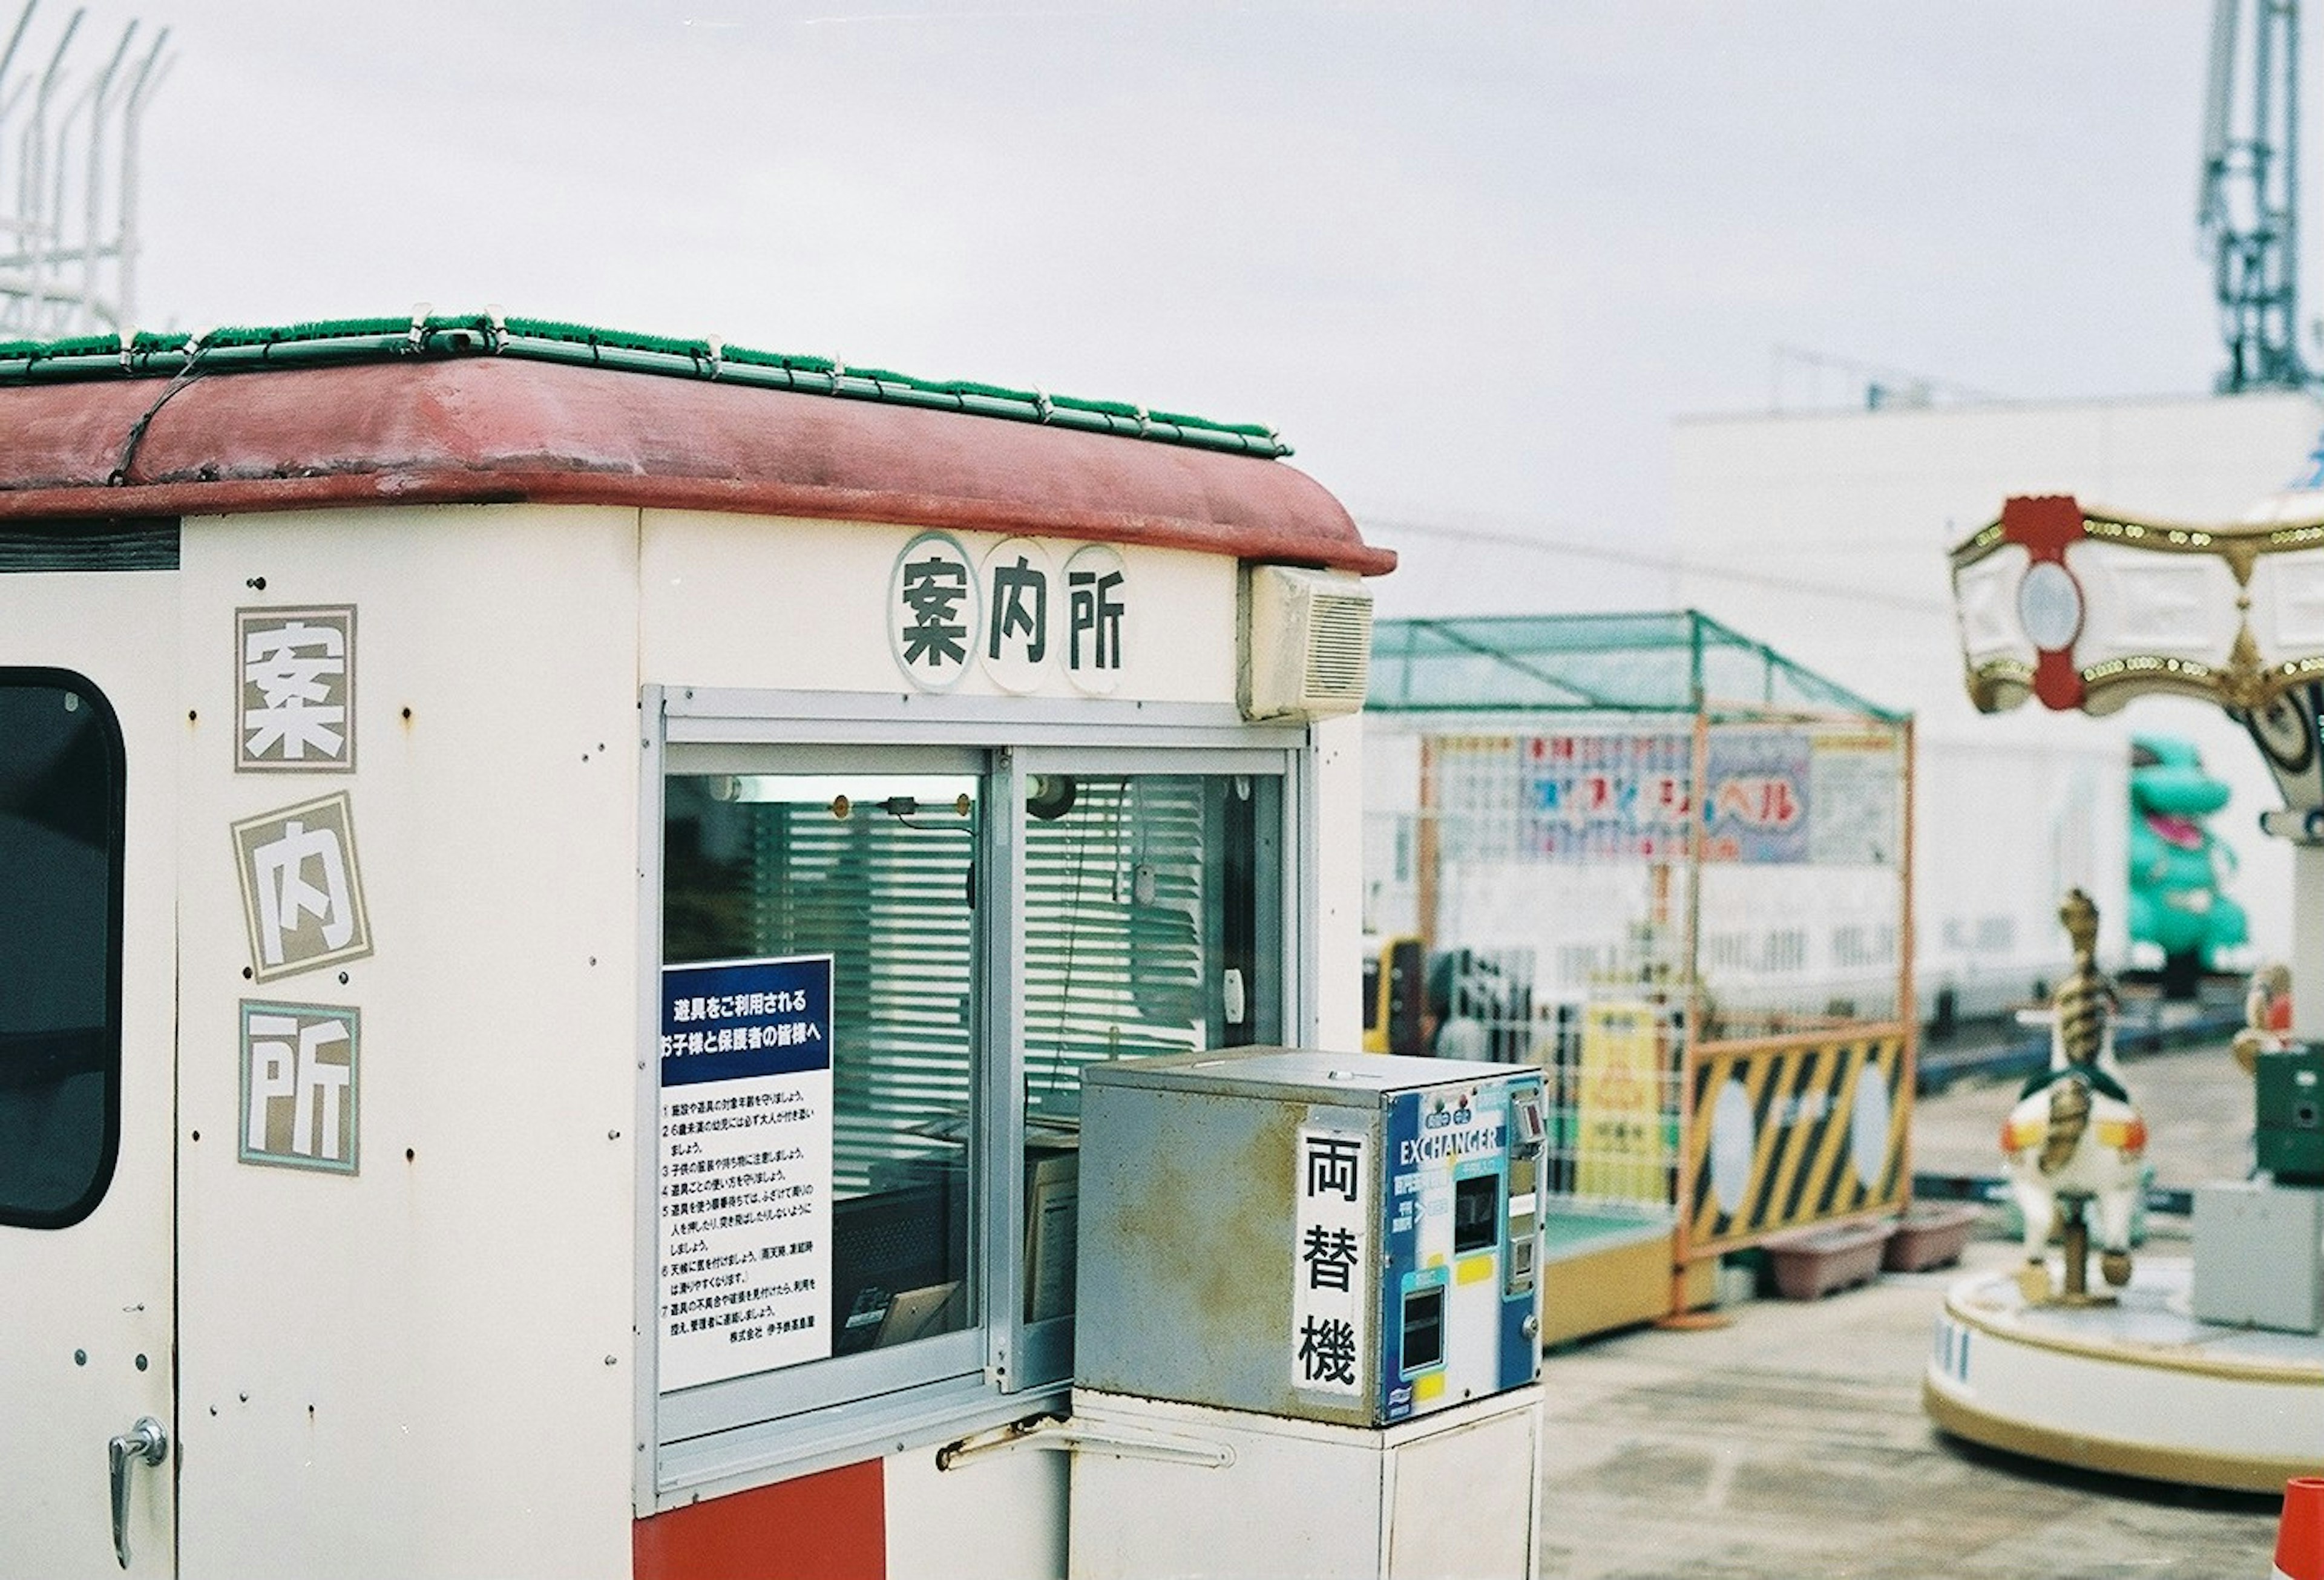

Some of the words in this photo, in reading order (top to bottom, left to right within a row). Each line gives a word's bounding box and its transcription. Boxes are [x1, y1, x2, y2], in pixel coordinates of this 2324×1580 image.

[902, 556, 1124, 670] 案内所
[245, 621, 350, 1159] 案内所
[660, 1021, 821, 1058] お子様と保護者の皆様へ
[673, 989, 806, 1023] 遊具をご利用される
[1400, 1127, 1497, 1165] EXCHANGER
[1298, 1137, 1362, 1386] 両替機
